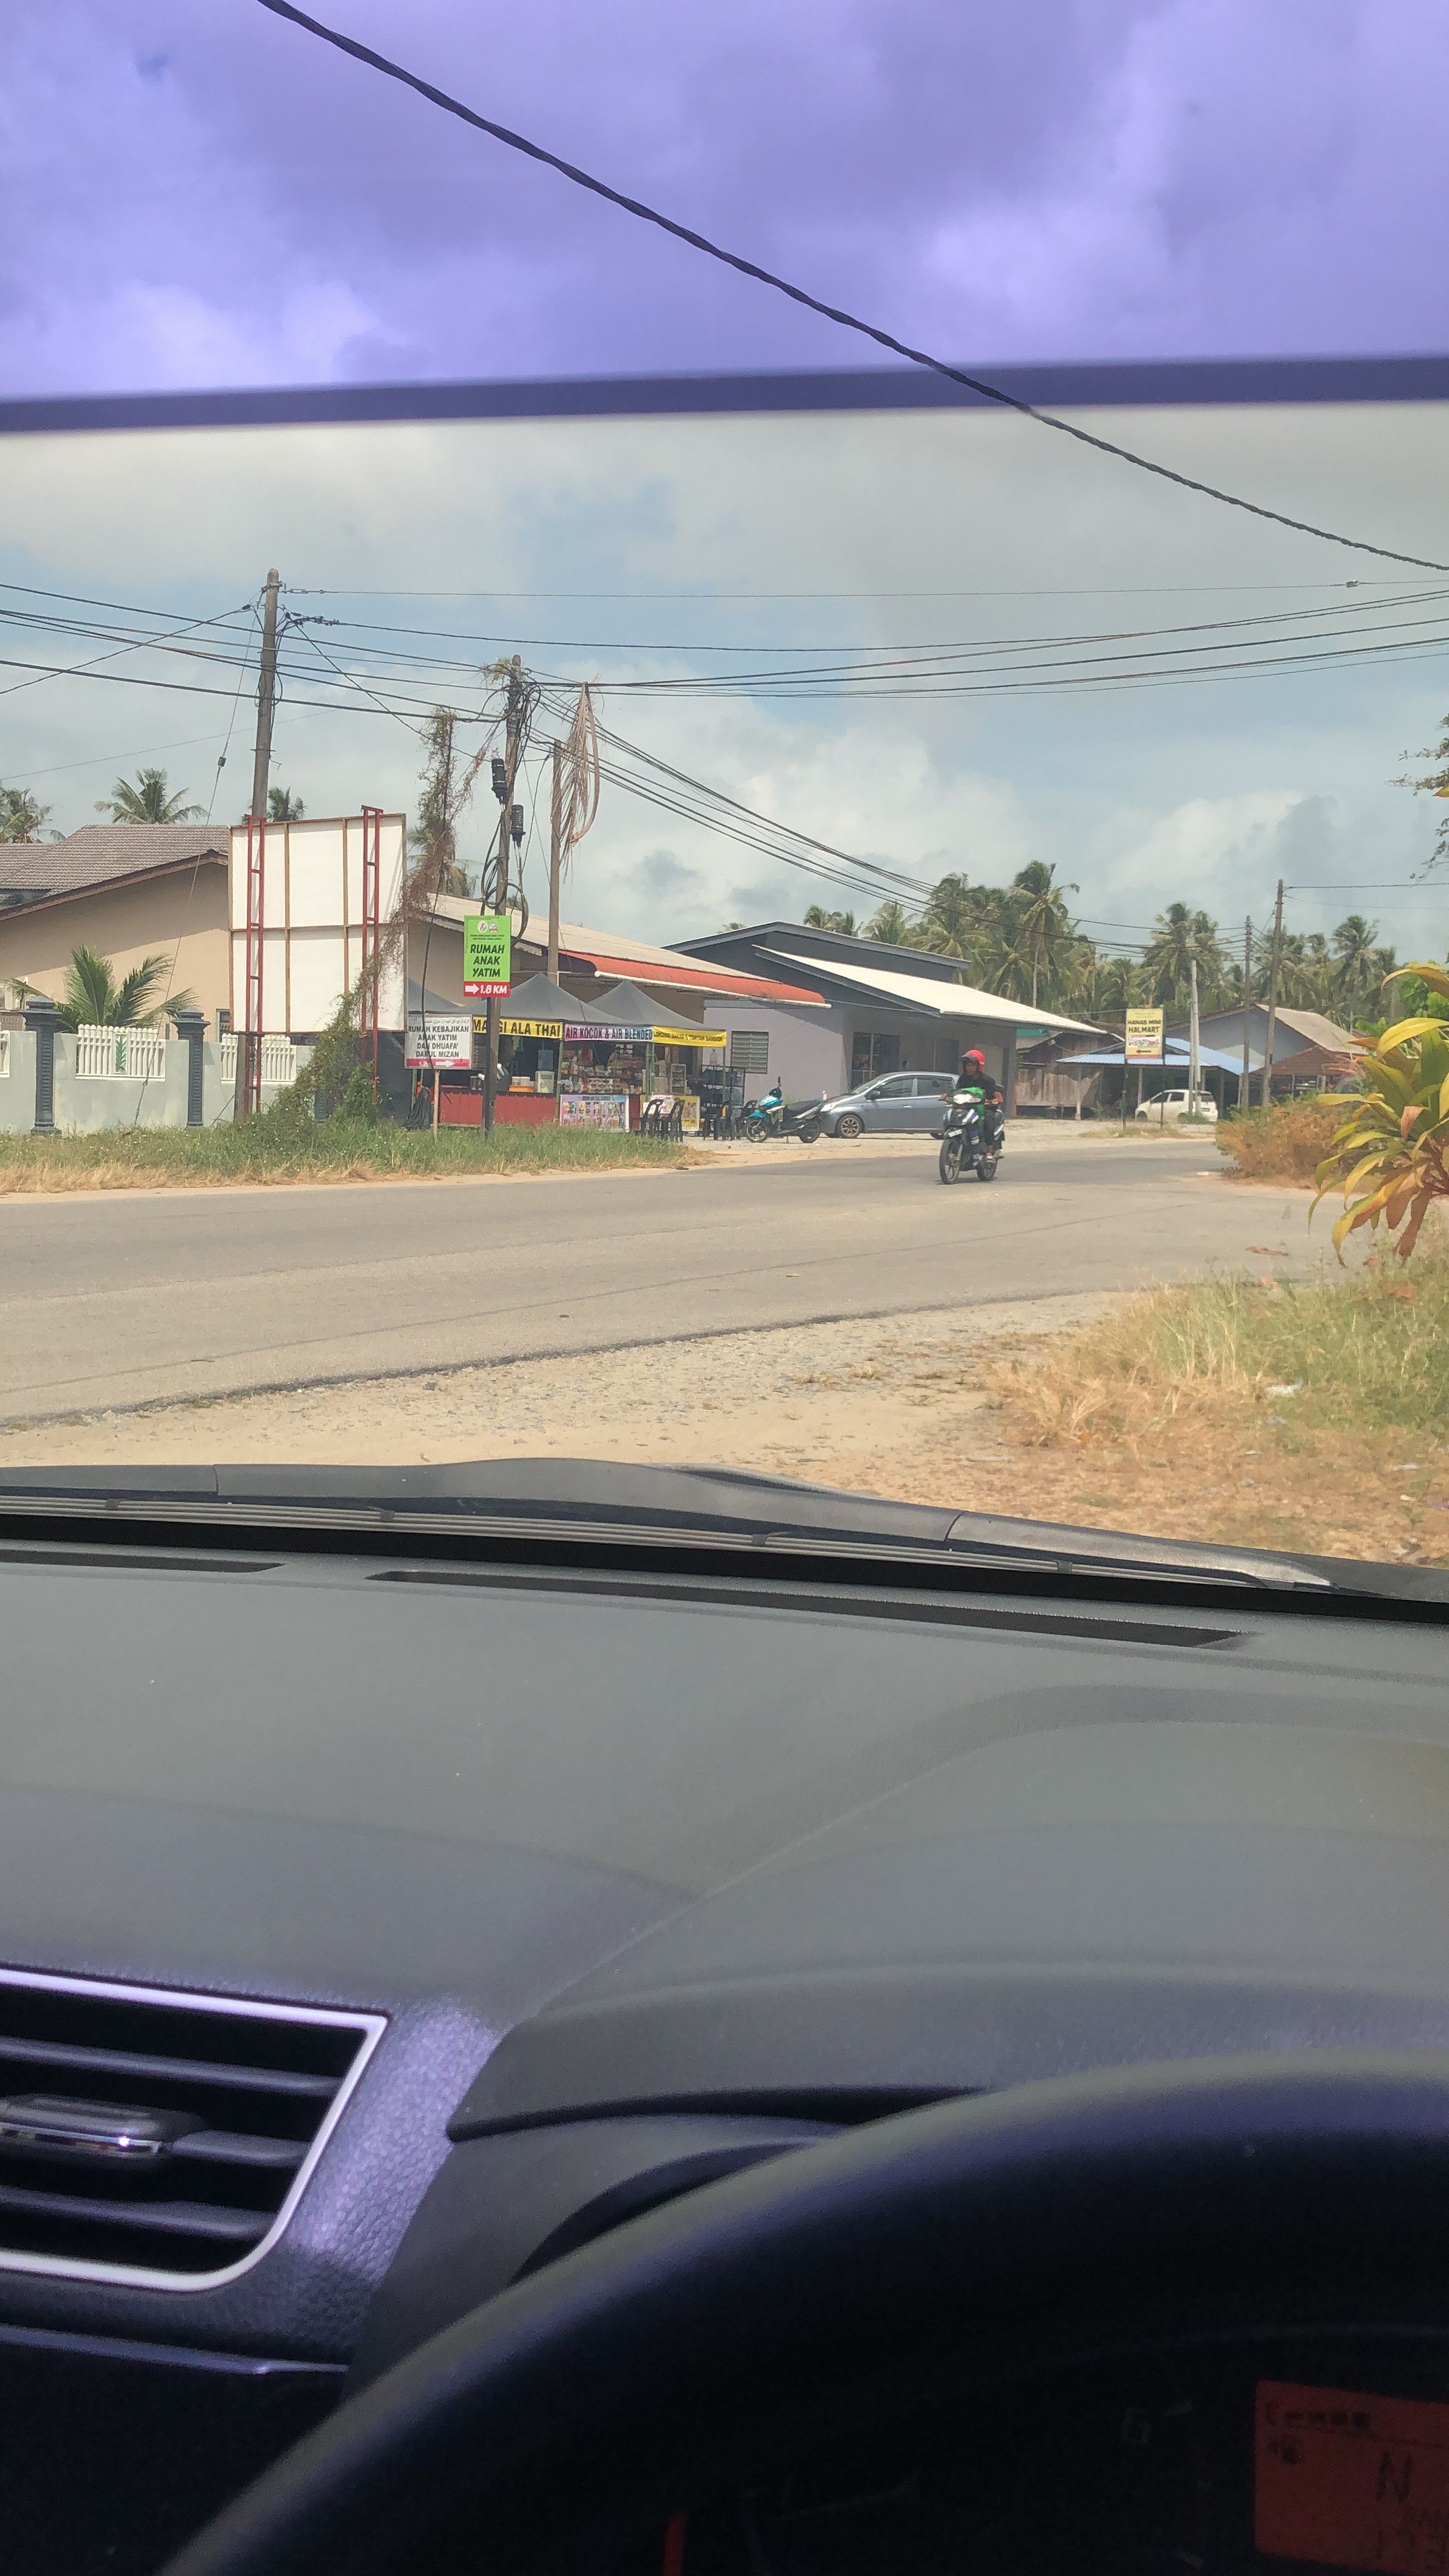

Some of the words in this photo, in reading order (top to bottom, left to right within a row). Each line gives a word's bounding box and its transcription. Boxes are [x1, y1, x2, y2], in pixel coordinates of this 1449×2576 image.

[470, 944, 505, 954] RUMAH
[473, 956, 501, 965] ANAK
[472, 967, 500, 977] YATIM
[480, 984, 492, 994] 1.8
[493, 985, 508, 994] KM
[511, 1022, 531, 1035] ALA
[535, 1024, 561, 1037] THAI
[566, 1027, 578, 1038] AIR
[580, 1027, 603, 1039] KOCOK
[604, 1028, 610, 1039] &
[611, 1028, 623, 1039] AIR
[625, 1028, 653, 1040] BLENDED
